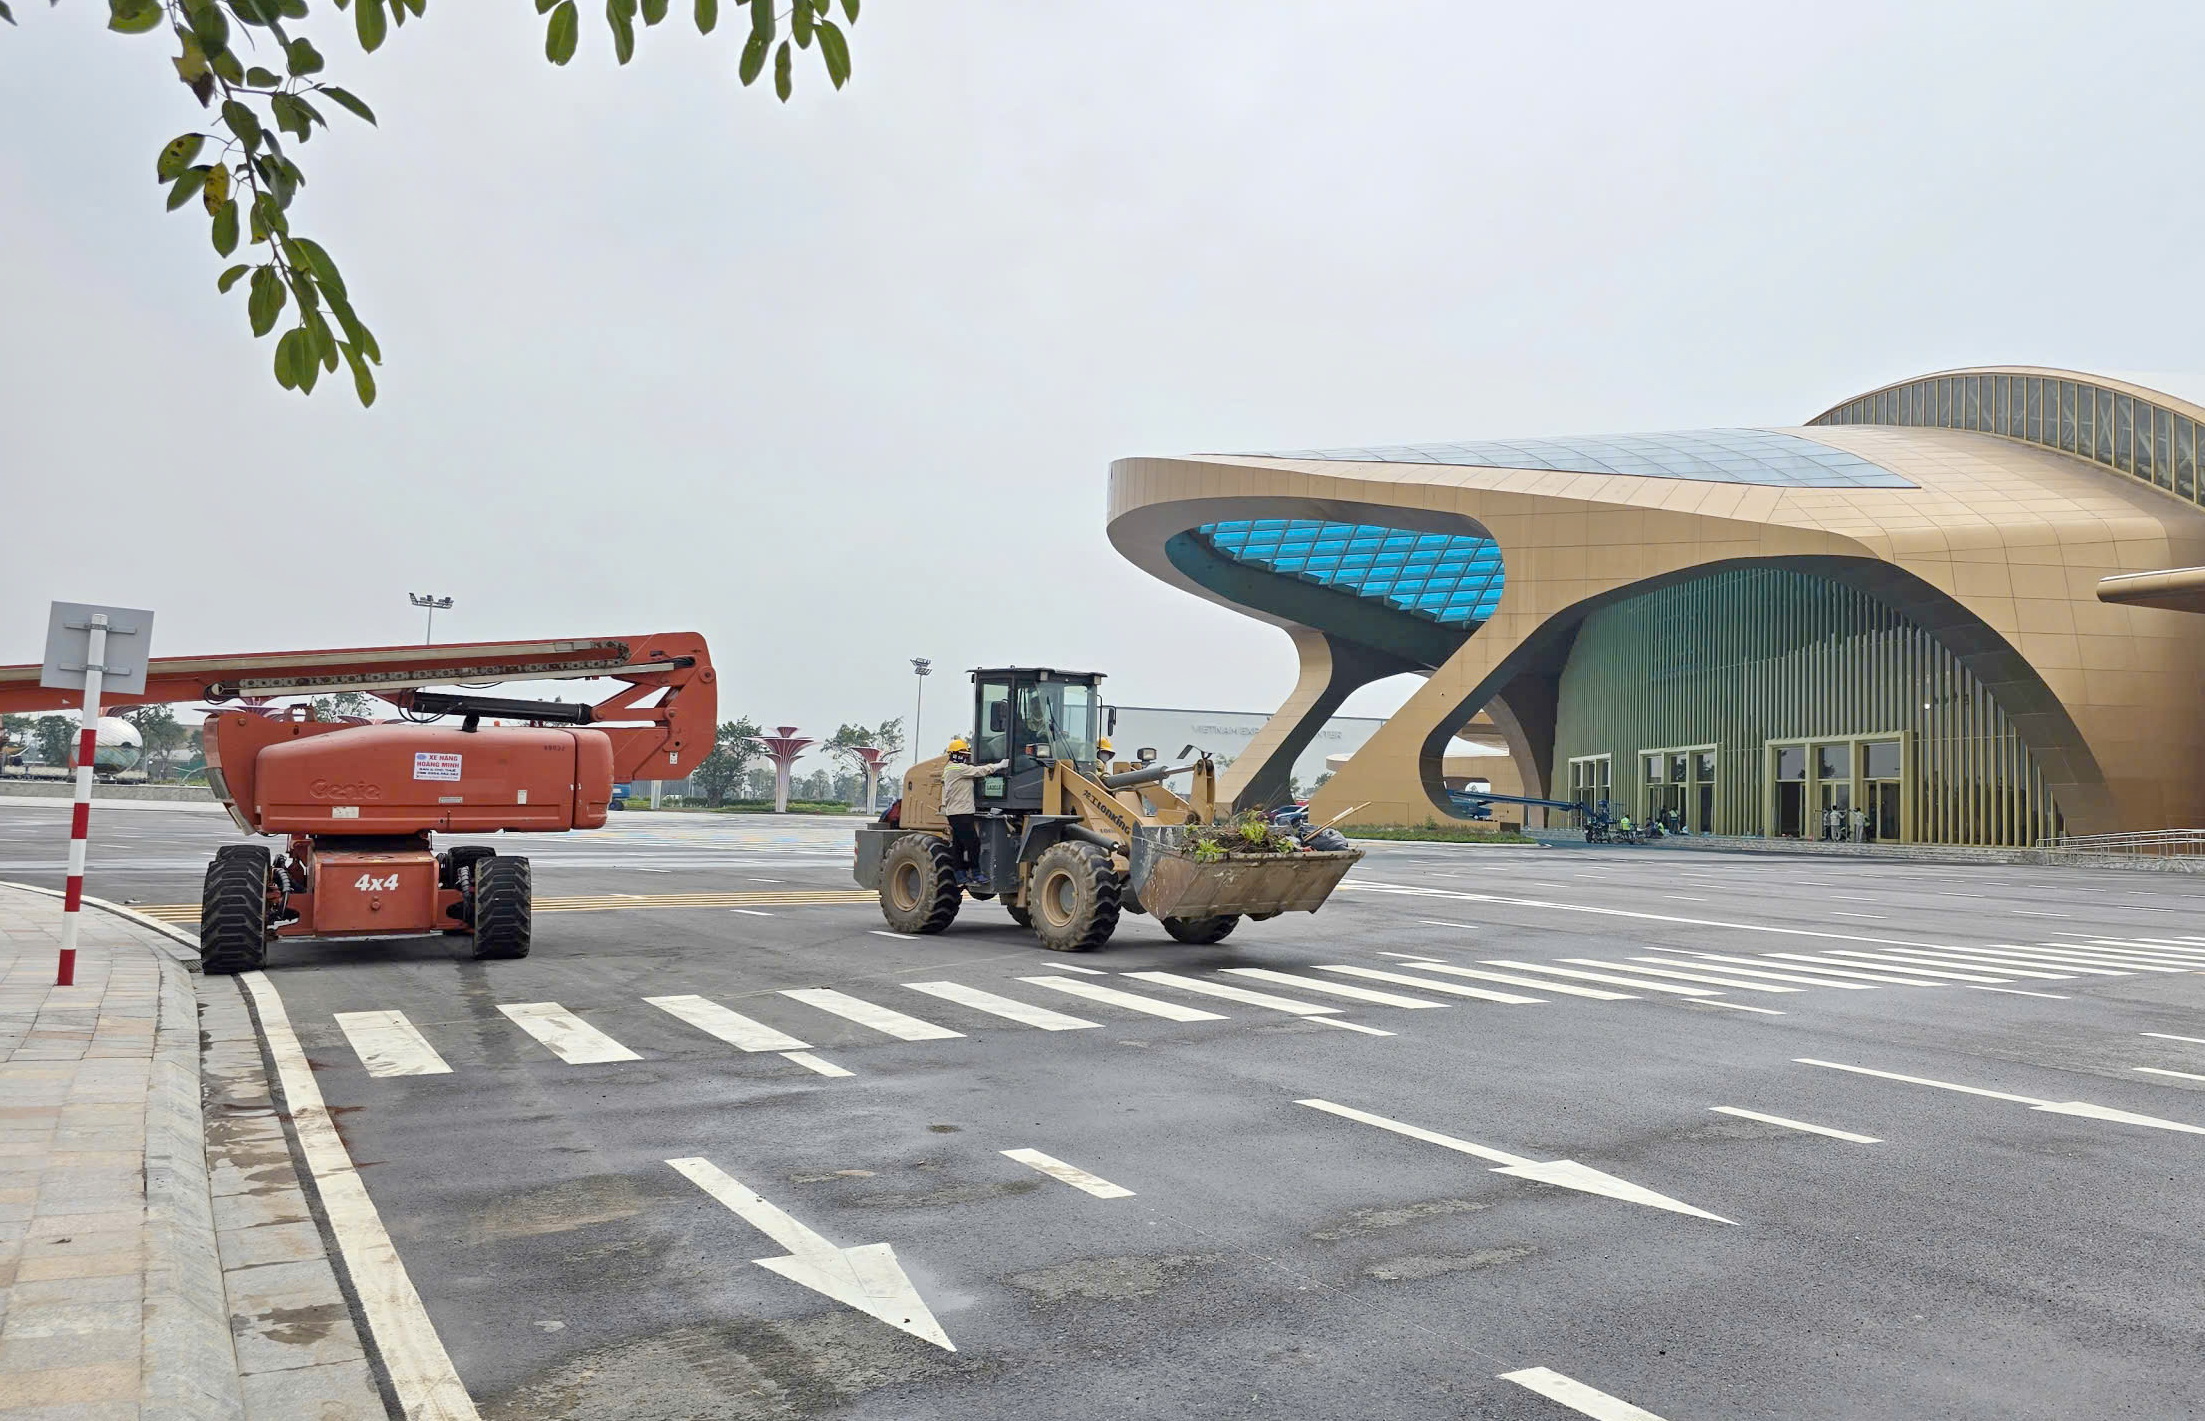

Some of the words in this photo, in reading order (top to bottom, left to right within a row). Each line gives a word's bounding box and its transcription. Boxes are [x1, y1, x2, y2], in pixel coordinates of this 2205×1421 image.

[1191, 725, 1237, 735] VIETNAM
[310, 778, 382, 799] Genie
[354, 873, 399, 891] 4x4
